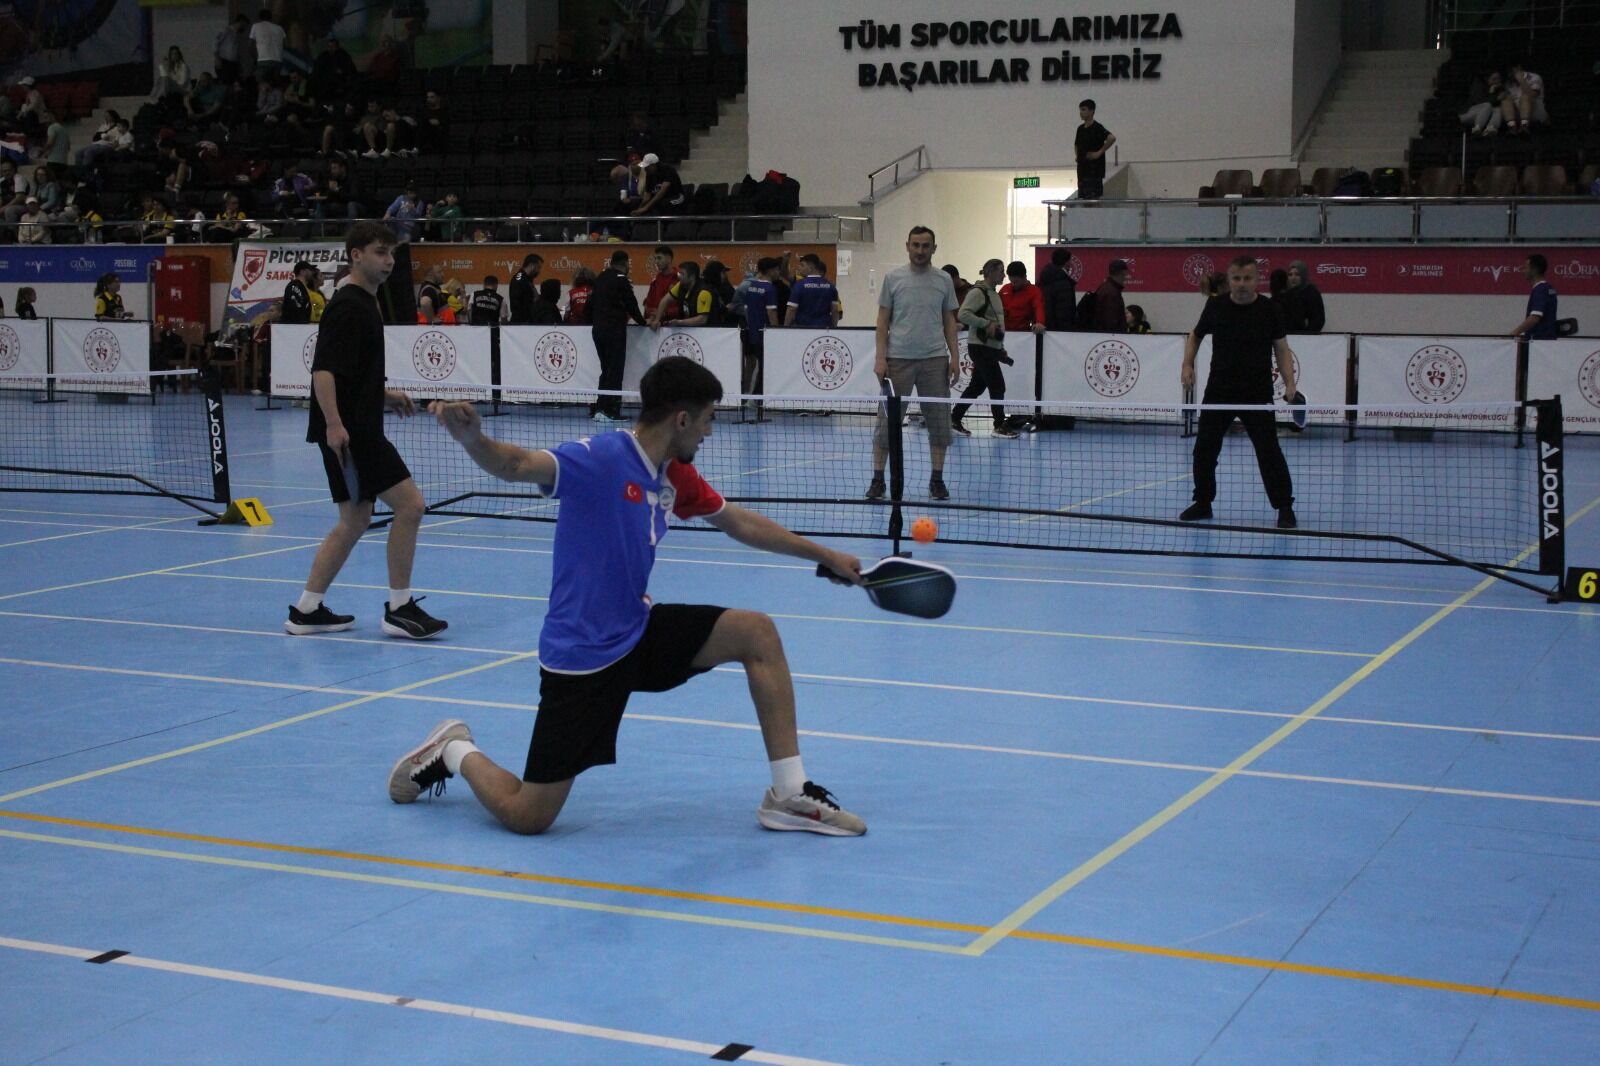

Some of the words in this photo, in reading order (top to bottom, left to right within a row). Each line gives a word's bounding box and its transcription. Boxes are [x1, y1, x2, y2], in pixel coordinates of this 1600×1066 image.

[839, 20, 901, 50] TÜM
[910, 12, 1182, 48] SPORCULARIMIZA
[858, 58, 1030, 92] BAŞARILAR
[1041, 47, 1162, 82] DİLERİZ
[1554, 262, 1600, 276] GLORIA
[245, 501, 262, 522] 7
[1542, 462, 1560, 540] JOOLA
[1578, 571, 1599, 599] 6
